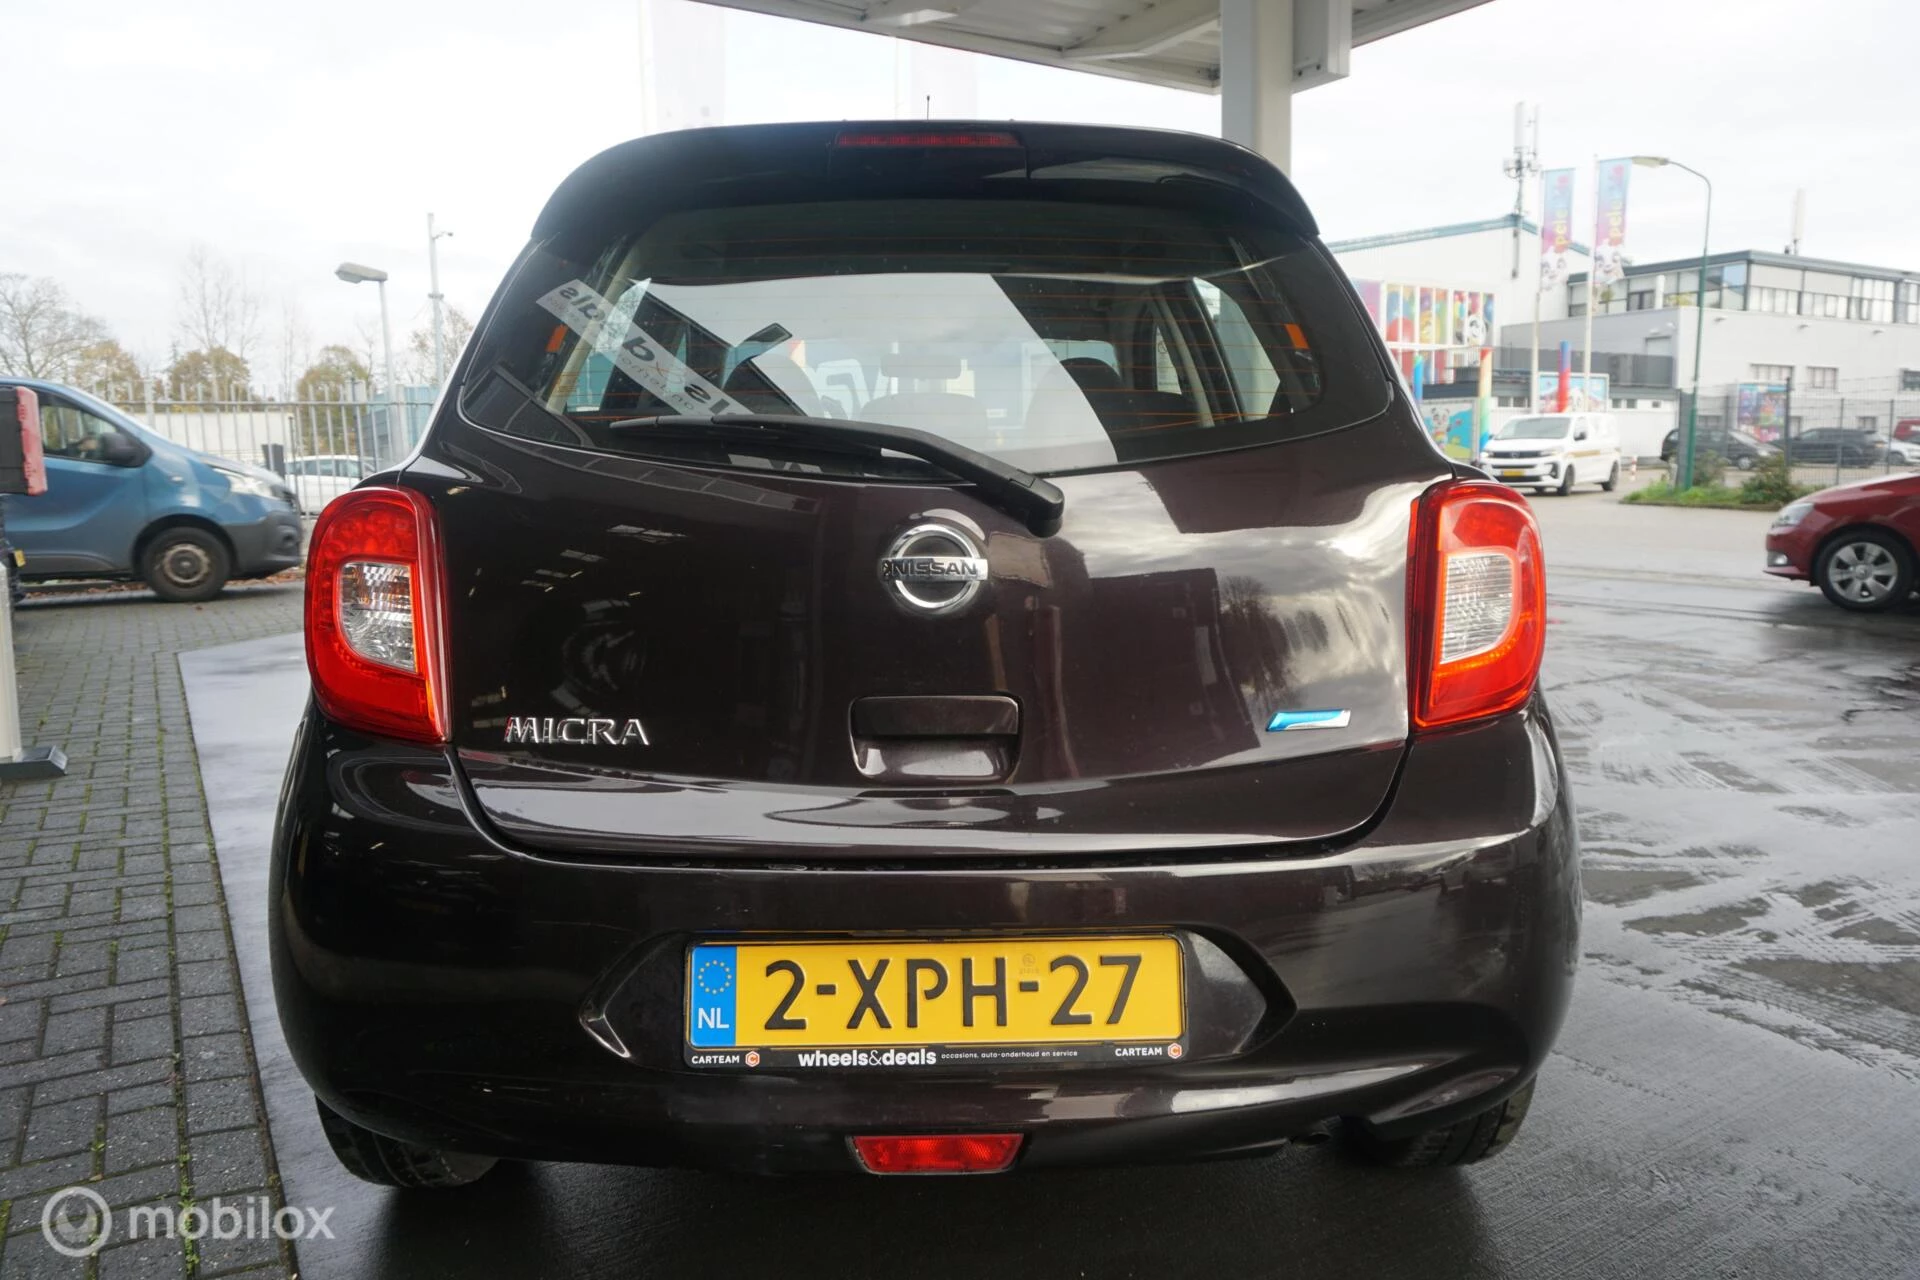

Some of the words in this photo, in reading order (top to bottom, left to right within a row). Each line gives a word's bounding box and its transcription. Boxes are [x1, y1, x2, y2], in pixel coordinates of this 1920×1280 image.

[891, 559, 978, 577] NISSAN
[504, 715, 650, 746] MICRA
[764, 955, 1143, 1031] 2-XPH-27
[696, 1006, 730, 1031] NL
[691, 1054, 740, 1065] CARTEAM
[798, 1048, 937, 1068] wheels&deals
[1115, 1047, 1163, 1058] CARTEAM
